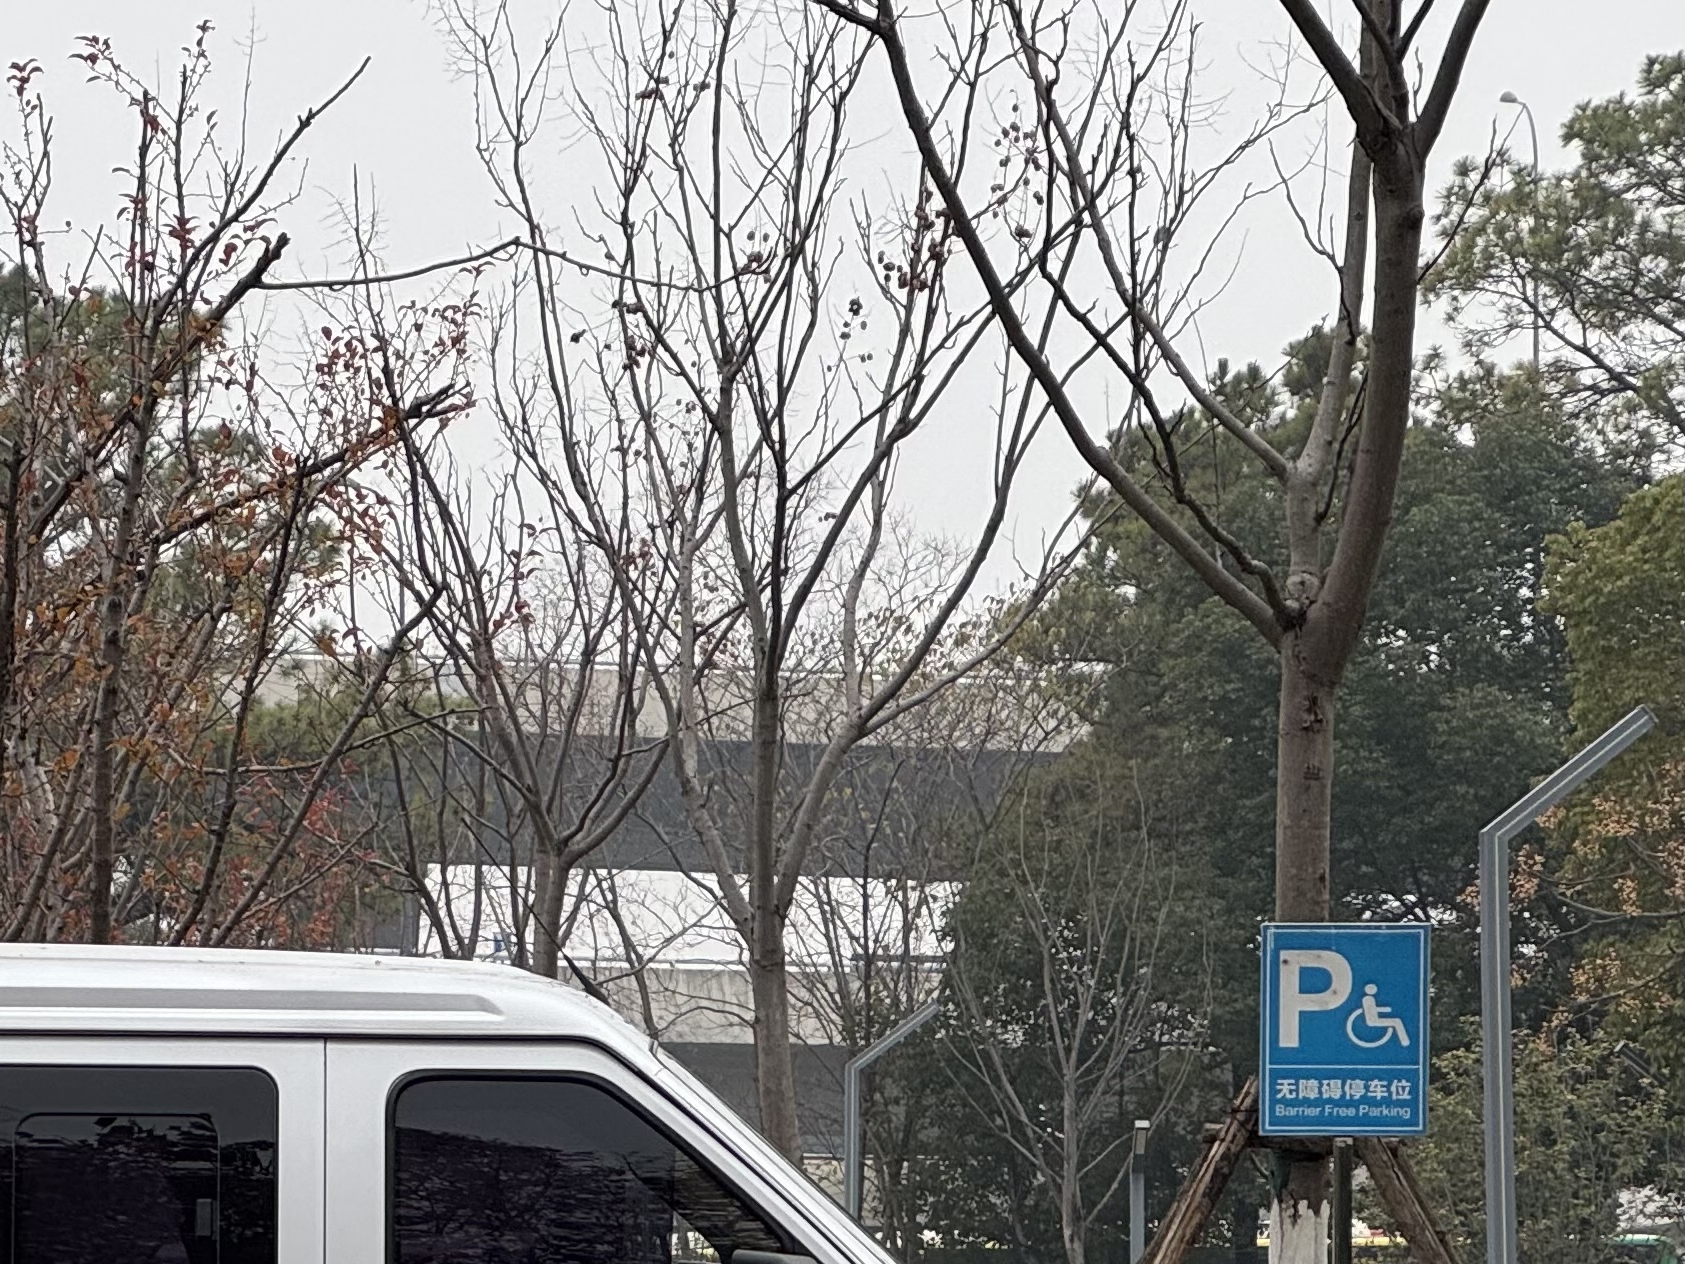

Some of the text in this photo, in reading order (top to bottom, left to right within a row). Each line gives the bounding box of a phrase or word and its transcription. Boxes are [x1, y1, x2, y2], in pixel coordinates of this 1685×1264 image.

[1279, 949, 1353, 1048] P
[1275, 1078, 1413, 1100] 无障碍停车位
[1275, 1104, 1411, 1119] Barrier Free Parking
